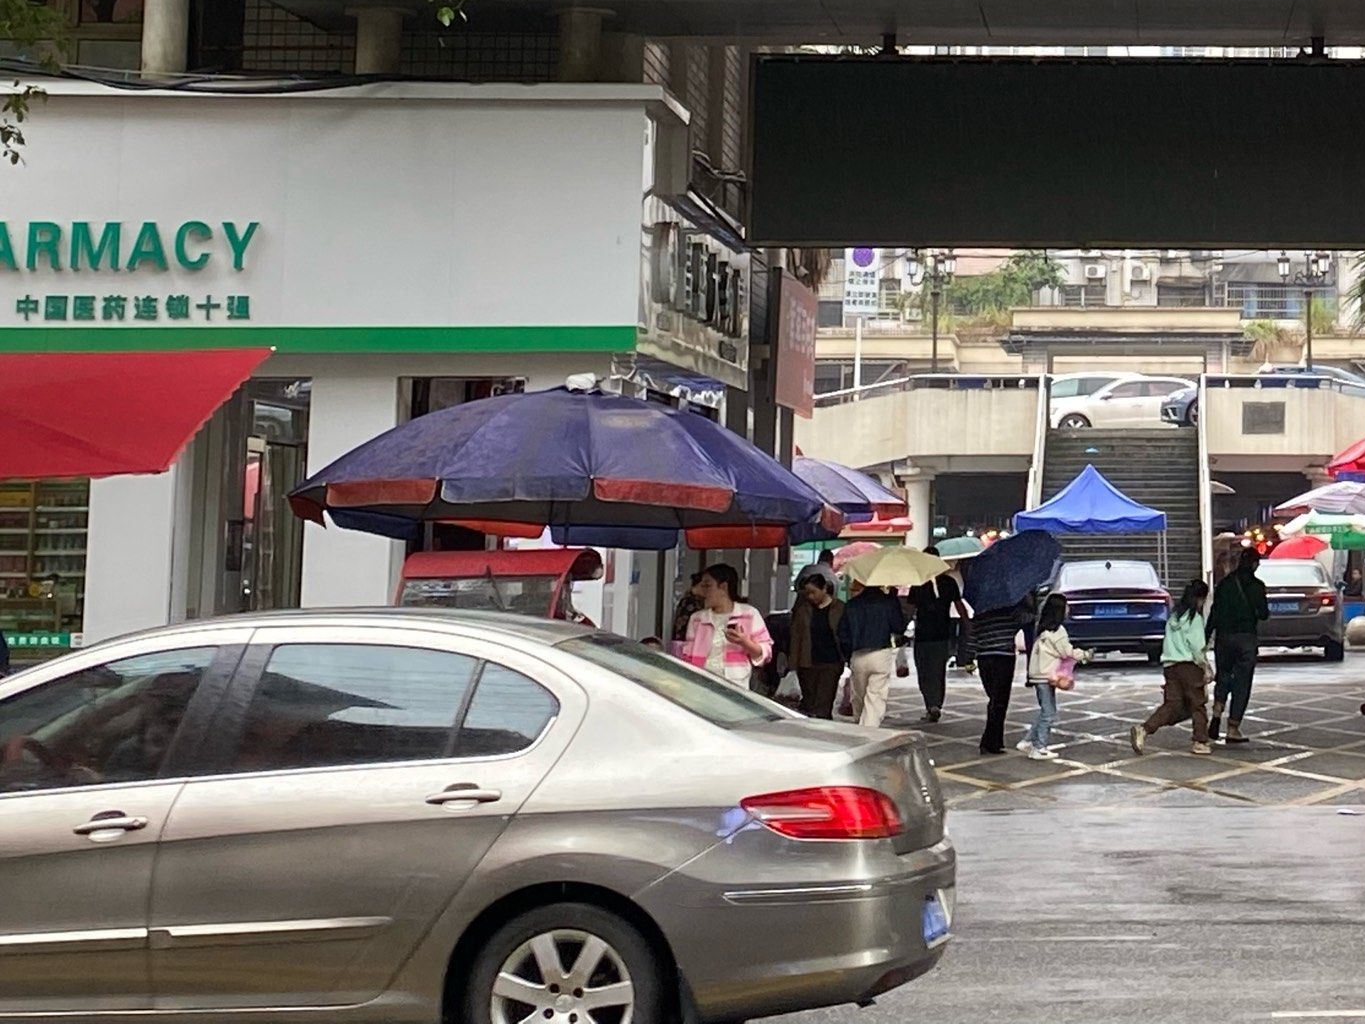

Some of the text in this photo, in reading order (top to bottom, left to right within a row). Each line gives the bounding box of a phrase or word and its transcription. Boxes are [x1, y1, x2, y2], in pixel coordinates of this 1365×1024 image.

[16, 294, 251, 321] 中国医药连锁十强
